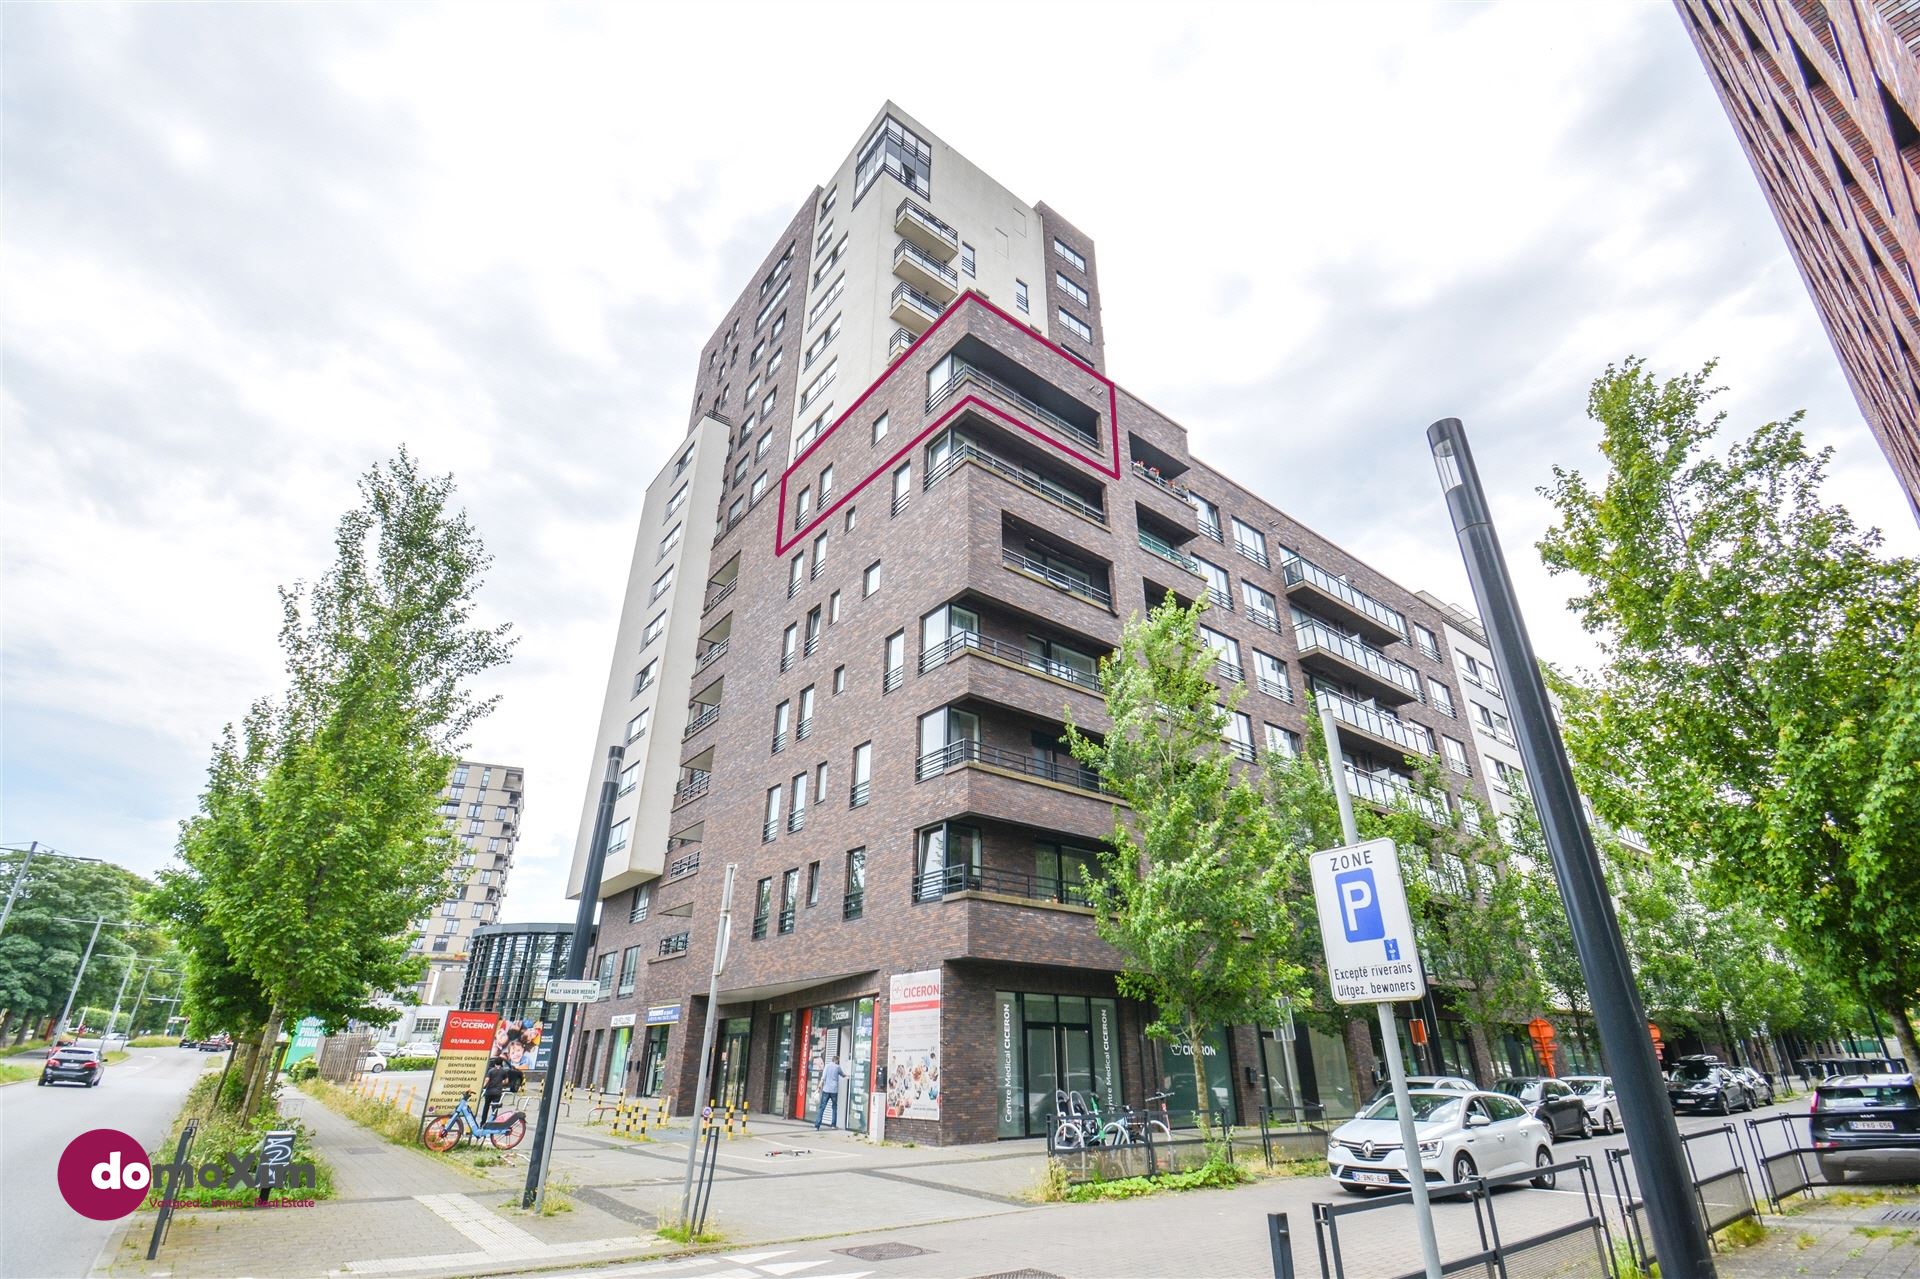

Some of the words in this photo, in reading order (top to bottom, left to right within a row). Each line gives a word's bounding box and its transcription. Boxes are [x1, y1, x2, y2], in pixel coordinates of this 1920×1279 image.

[1330, 850, 1373, 872] ZONE
[1341, 880, 1372, 931] P
[1335, 965, 1369, 981] Excepté
[1371, 962, 1413, 978] riverains
[903, 984, 940, 998] CICERON
[1337, 984, 1368, 998] Uitgez.
[1370, 980, 1416, 994] bewoners
[1003, 1003, 1011, 1049] CICERON
[1101, 1009, 1110, 1051] CICERON
[1183, 1044, 1216, 1056] CICRON
[1004, 1089, 1012, 1122] Centre
